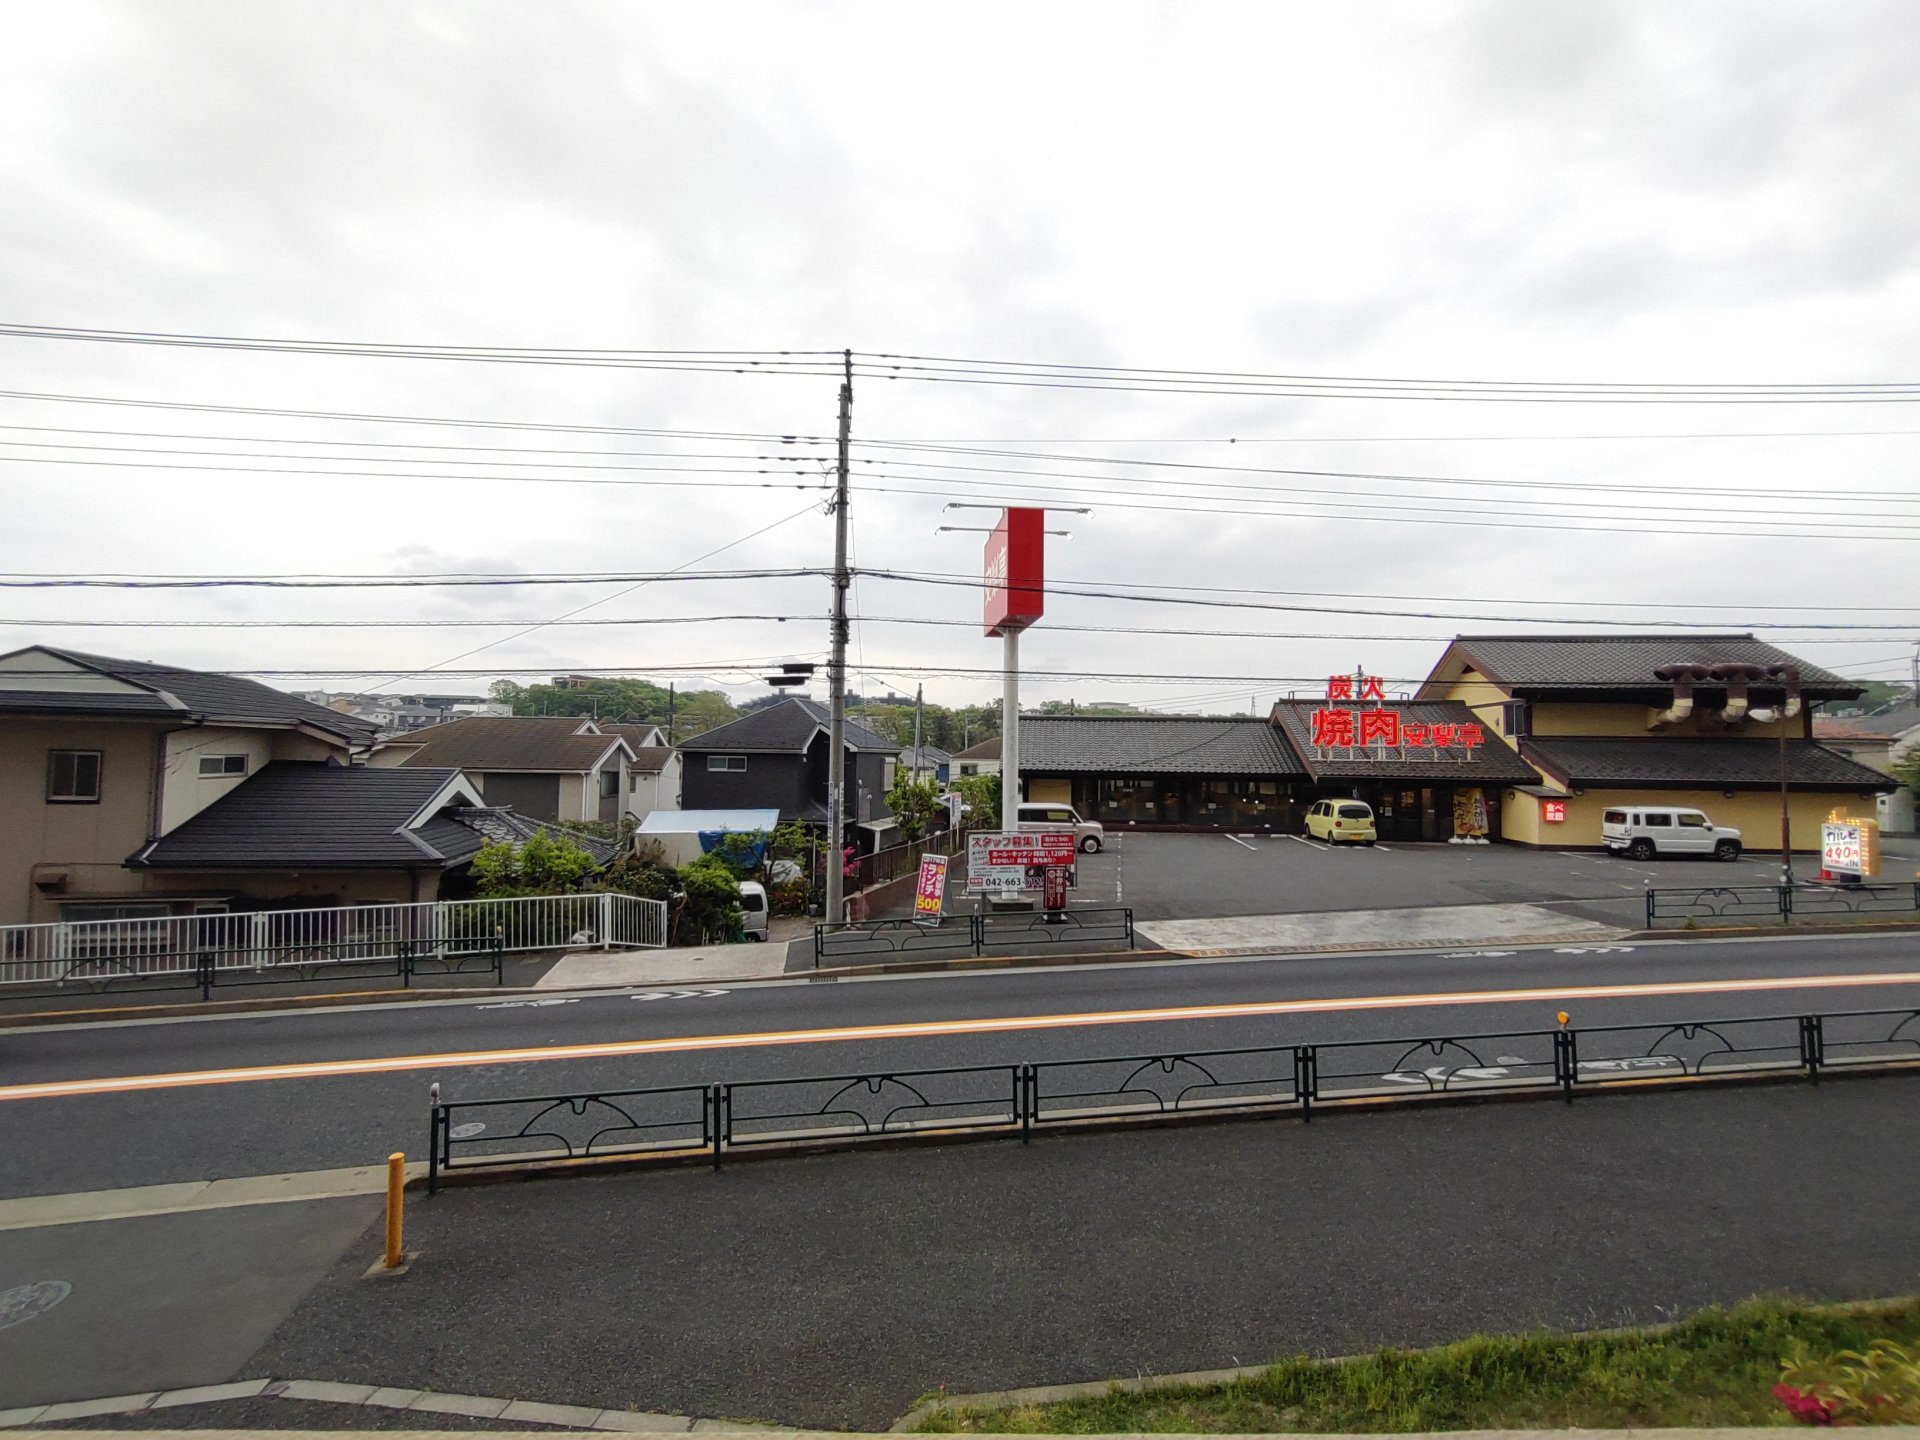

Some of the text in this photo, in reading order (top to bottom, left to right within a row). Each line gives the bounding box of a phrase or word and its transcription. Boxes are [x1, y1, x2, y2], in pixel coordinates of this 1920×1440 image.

[1328, 675, 1386, 699] 炭火
[1312, 707, 1400, 748] 焼肉
[1546, 803, 1564, 813] 食べ
